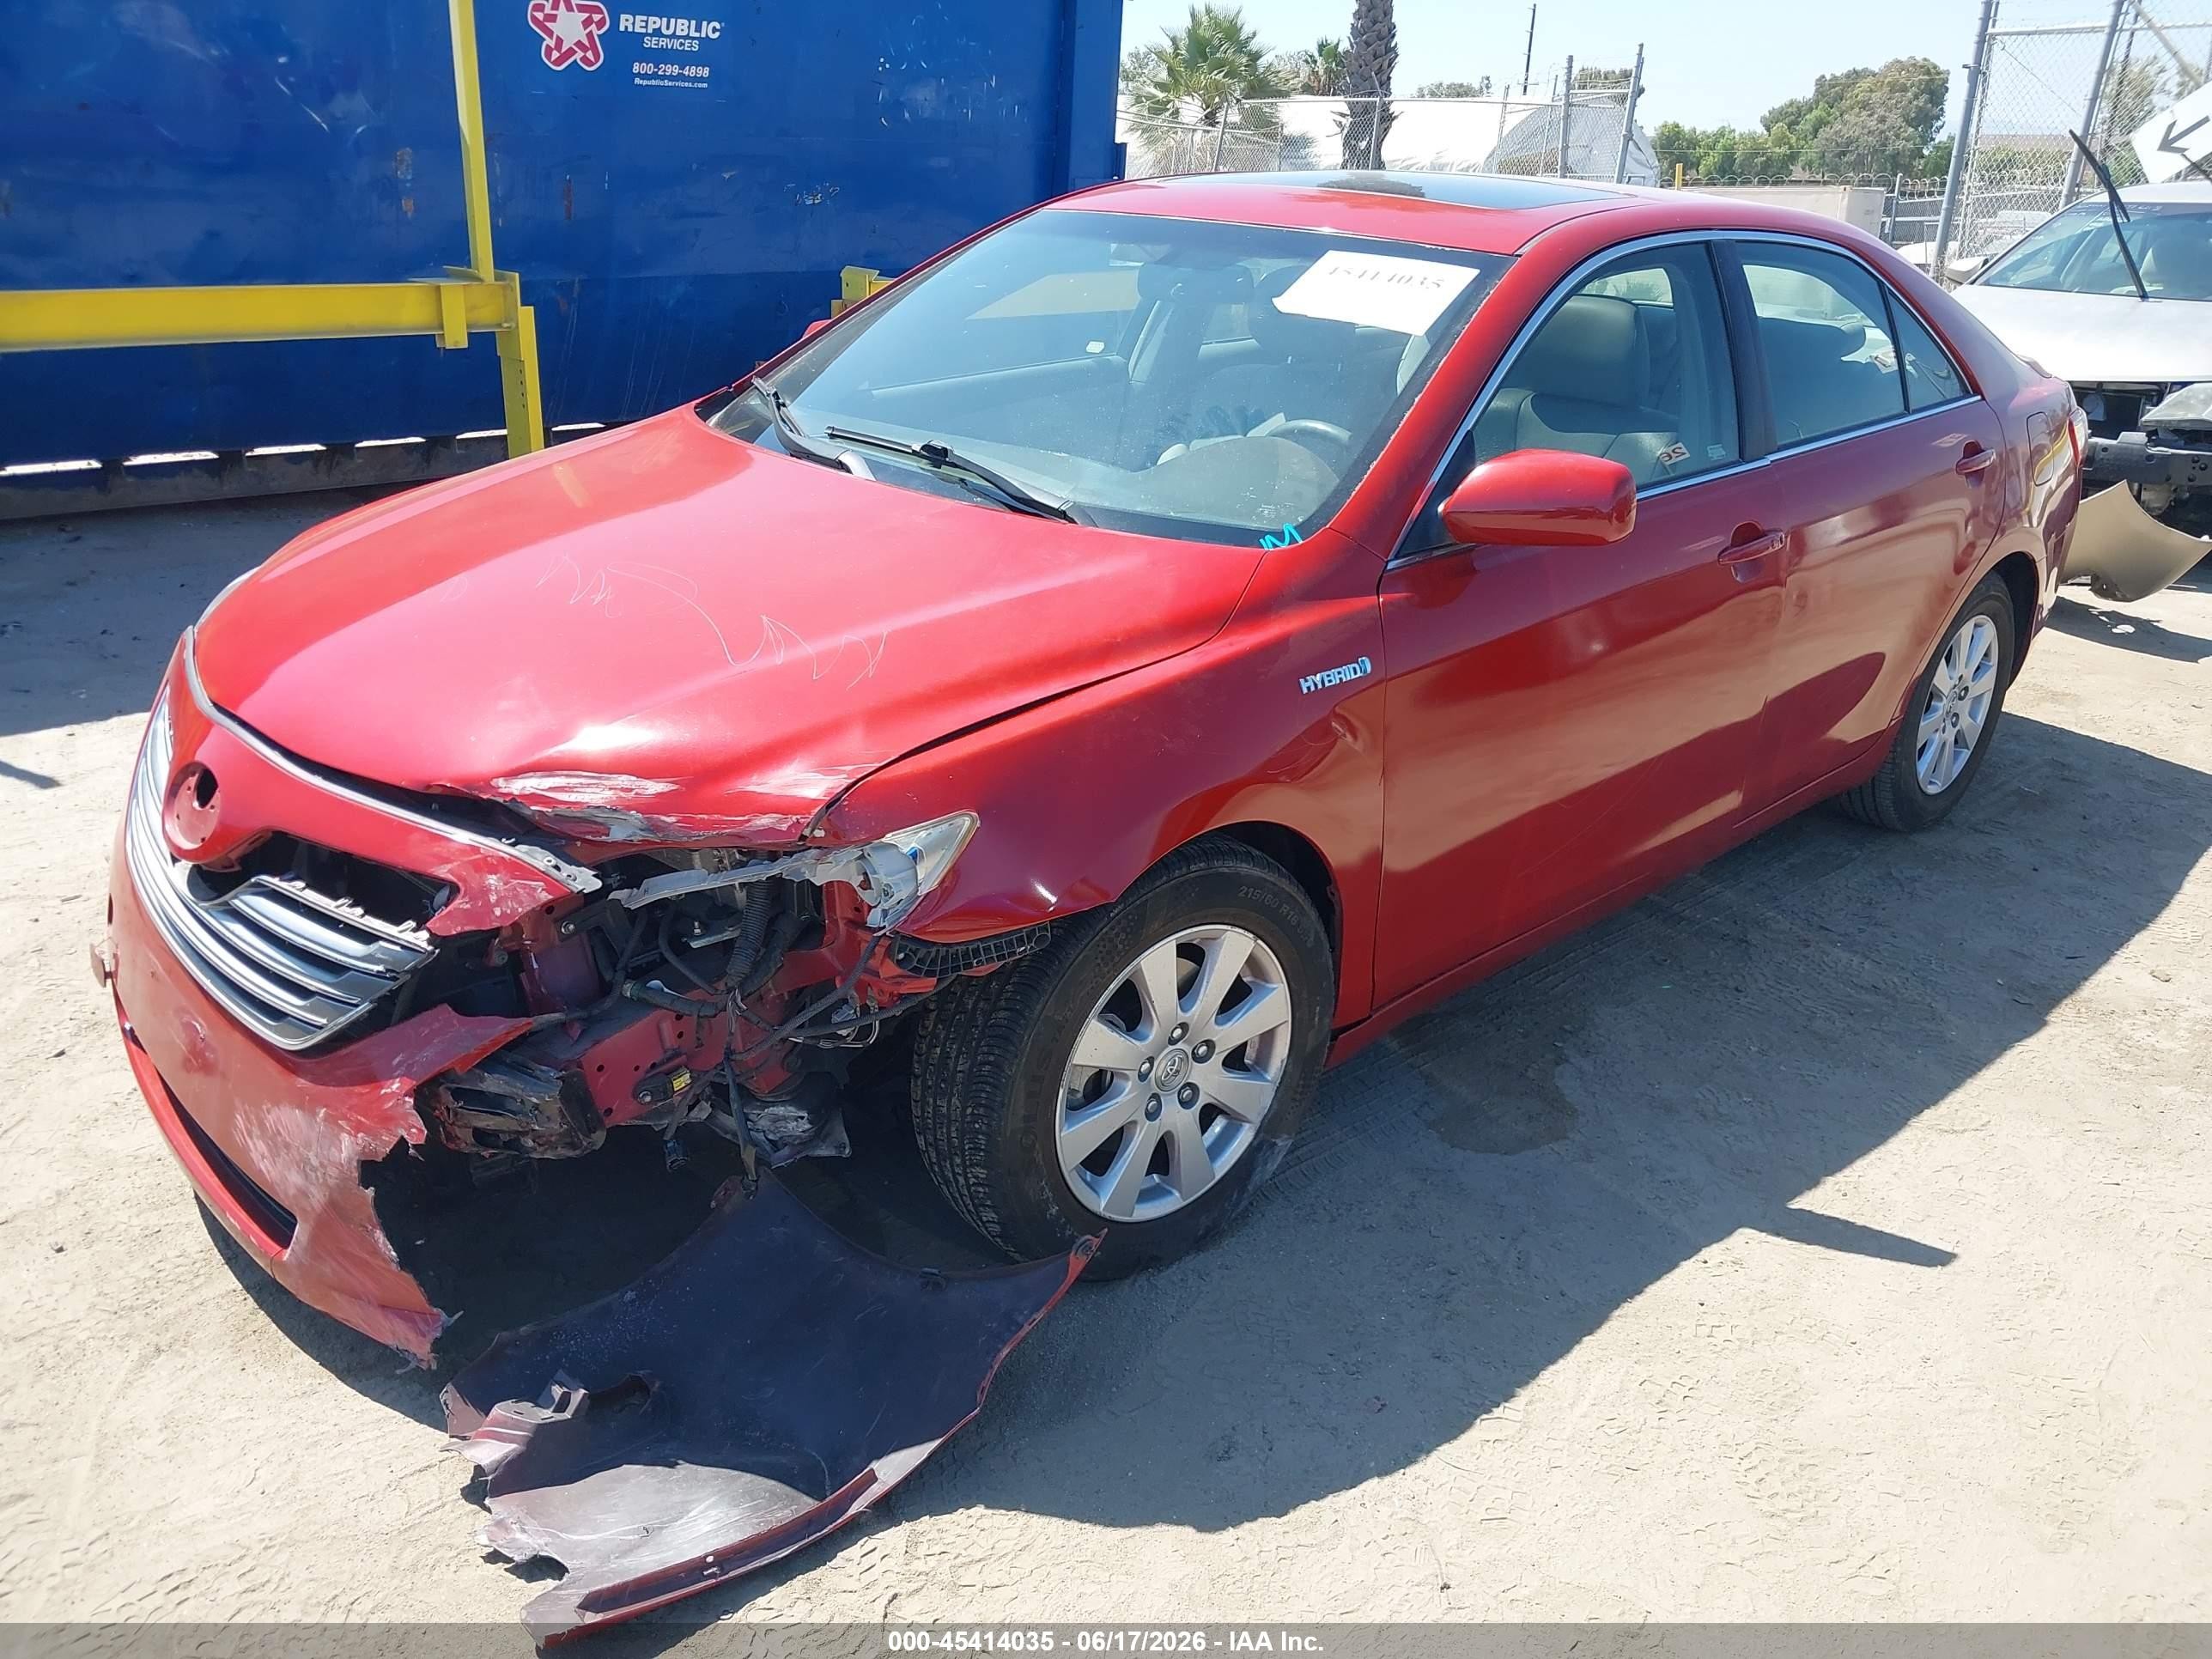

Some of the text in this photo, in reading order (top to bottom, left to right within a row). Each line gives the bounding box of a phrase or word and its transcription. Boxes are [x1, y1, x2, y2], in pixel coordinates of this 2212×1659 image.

[619, 14, 721, 39] REPUBLIC
[643, 36, 700, 52] SERVICES
[632, 62, 710, 78] 800-299-4898
[634, 77, 708, 89] RepublicServices.com
[1298, 659, 1364, 695] HYBRID
[1237, 885, 1279, 908] 215/60
